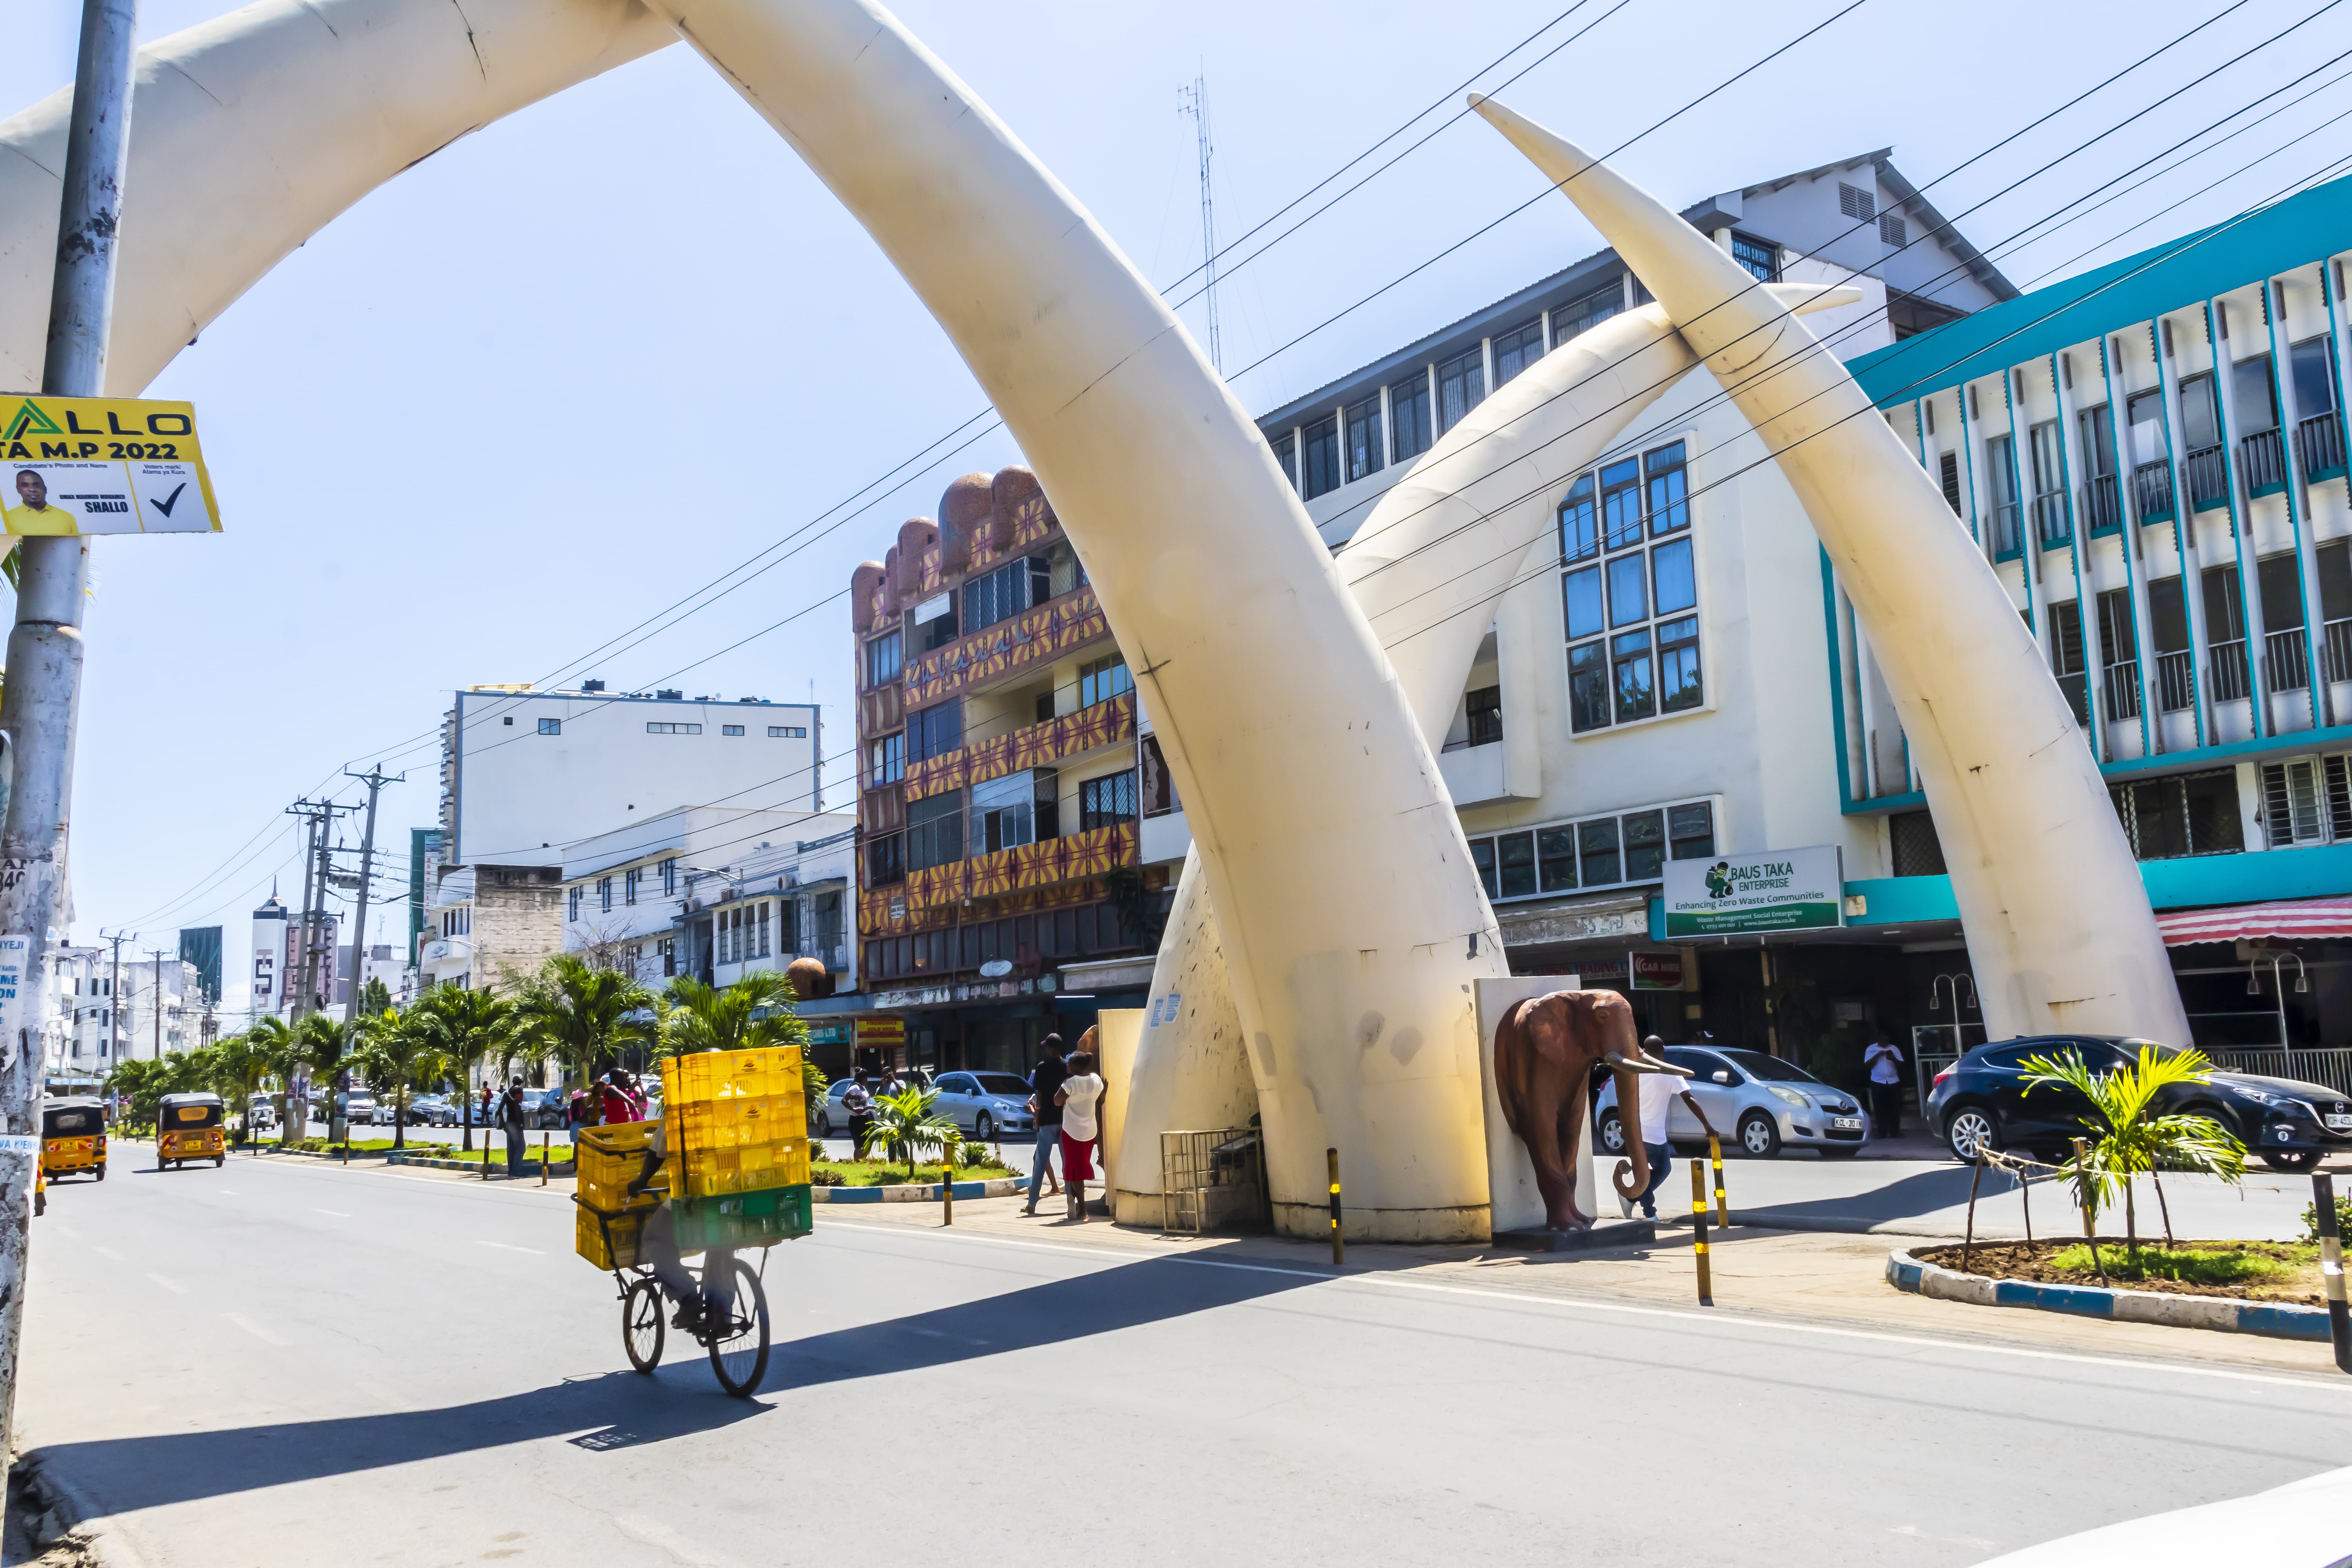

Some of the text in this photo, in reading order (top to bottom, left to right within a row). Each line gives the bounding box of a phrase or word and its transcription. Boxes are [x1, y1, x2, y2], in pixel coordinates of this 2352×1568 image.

[0, 398, 191, 440] ALLO
[40, 442, 99, 458] M.P
[107, 442, 179, 459] 2022
[84, 501, 129, 513] SHALLO
[1730, 862, 1794, 881] BAUS TAKA
[1739, 878, 1789, 891] ENTERPRISE
[1676, 891, 1824, 910] Enhancing Zero Waste Communities
[1574, 962, 1618, 974] TRADING
[1641, 963, 1681, 972] CAR HIRE
[825, 1027, 836, 1037] LTD
